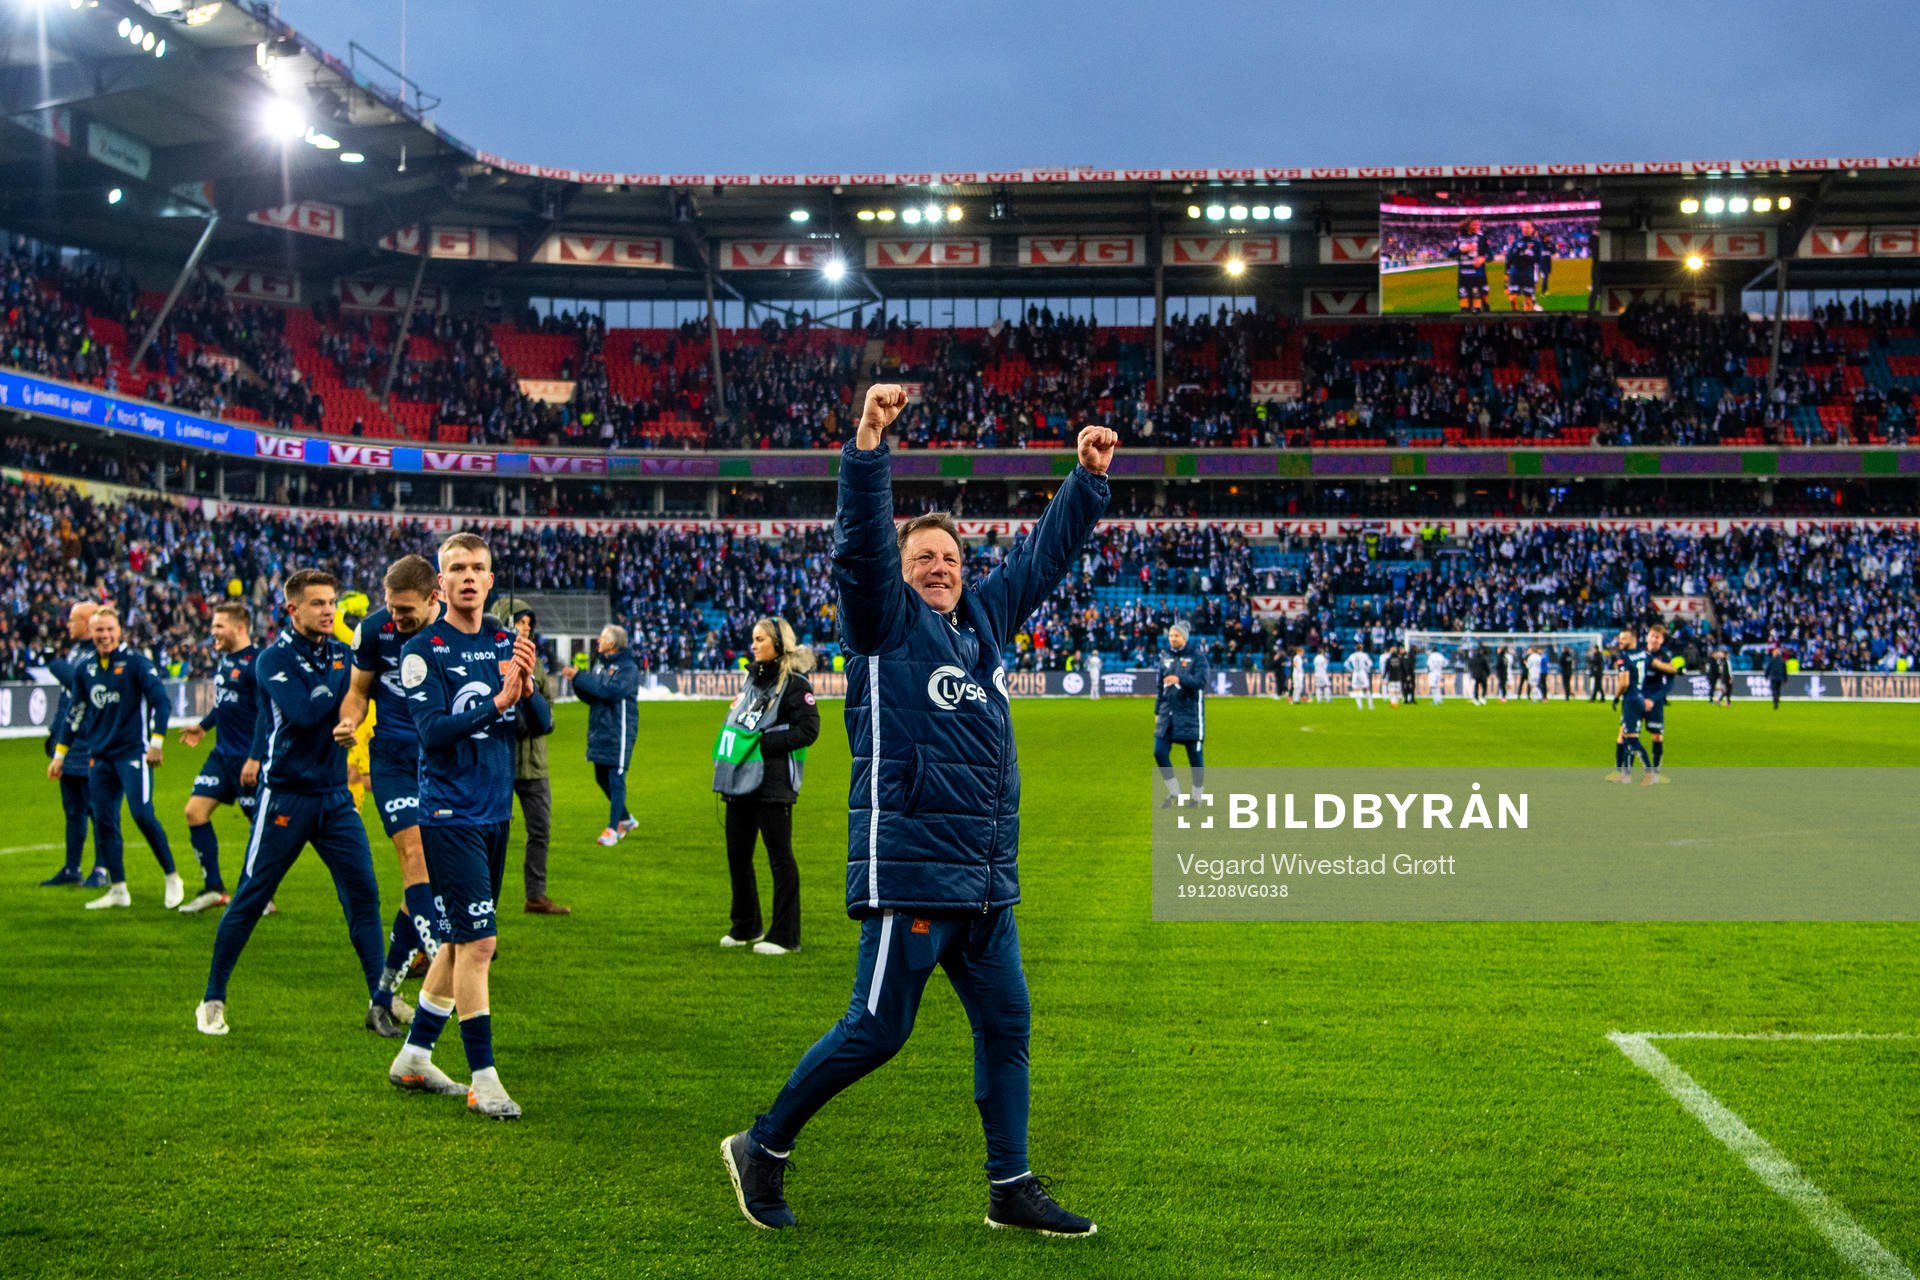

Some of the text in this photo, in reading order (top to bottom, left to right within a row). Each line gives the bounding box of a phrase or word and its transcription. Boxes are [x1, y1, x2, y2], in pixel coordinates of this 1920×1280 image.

[540, 168, 569, 178] VG
[581, 173, 612, 183] VG
[626, 175, 658, 184] VG
[671, 175, 703, 184] VG
[716, 176, 748, 184] VG
[761, 176, 793, 184] VG
[806, 176, 838, 184] VG
[851, 175, 883, 184] VG
[897, 174, 930, 183] VG
[942, 174, 974, 183] VG
[988, 173, 1021, 182] VG
[1034, 172, 1066, 181] VG
[1080, 172, 1112, 181] VG
[1126, 171, 1158, 180] VG
[1172, 170, 1205, 180] VG
[1219, 170, 1252, 179] VG
[1265, 169, 1298, 179] VG
[1313, 169, 1345, 178] VG
[1359, 168, 1392, 177] VG
[1407, 167, 1440, 176] VG
[1455, 167, 1488, 176] VG
[1502, 166, 1535, 175] VG
[1550, 165, 1583, 174] VG
[1598, 164, 1632, 173] VG
[1645, 163, 1679, 172] VG
[1694, 162, 1728, 170] VG
[1743, 161, 1777, 170] VG
[1792, 160, 1825, 169] VG
[1841, 160, 1874, 168] VG
[1890, 159, 1920, 168] VG
[266, 203, 332, 237] VG
[397, 224, 470, 259] VG
[566, 238, 660, 263] VG
[1033, 239, 1132, 263] VG
[1176, 239, 1277, 262] VG
[1660, 235, 1760, 257] VG
[1813, 229, 1918, 255] VG
[737, 243, 832, 266] VG
[881, 241, 979, 265] VG
[205, 267, 290, 298] VG
[1255, 383, 1296, 394] VG
[1622, 380, 1663, 392] VG
[256, 434, 719, 475] VG VG VG VG VG
[961, 522, 1007, 534] VG
[1275, 522, 1325, 535] VG
[1254, 598, 1303, 611] VG
[1655, 598, 1703, 612] VG
[474, 651, 496, 660] OBOS
[677, 673, 692, 695] VI
[1008, 673, 1046, 694] 2019
[1841, 676, 1857, 697] VI
[385, 796, 419, 813] coo
